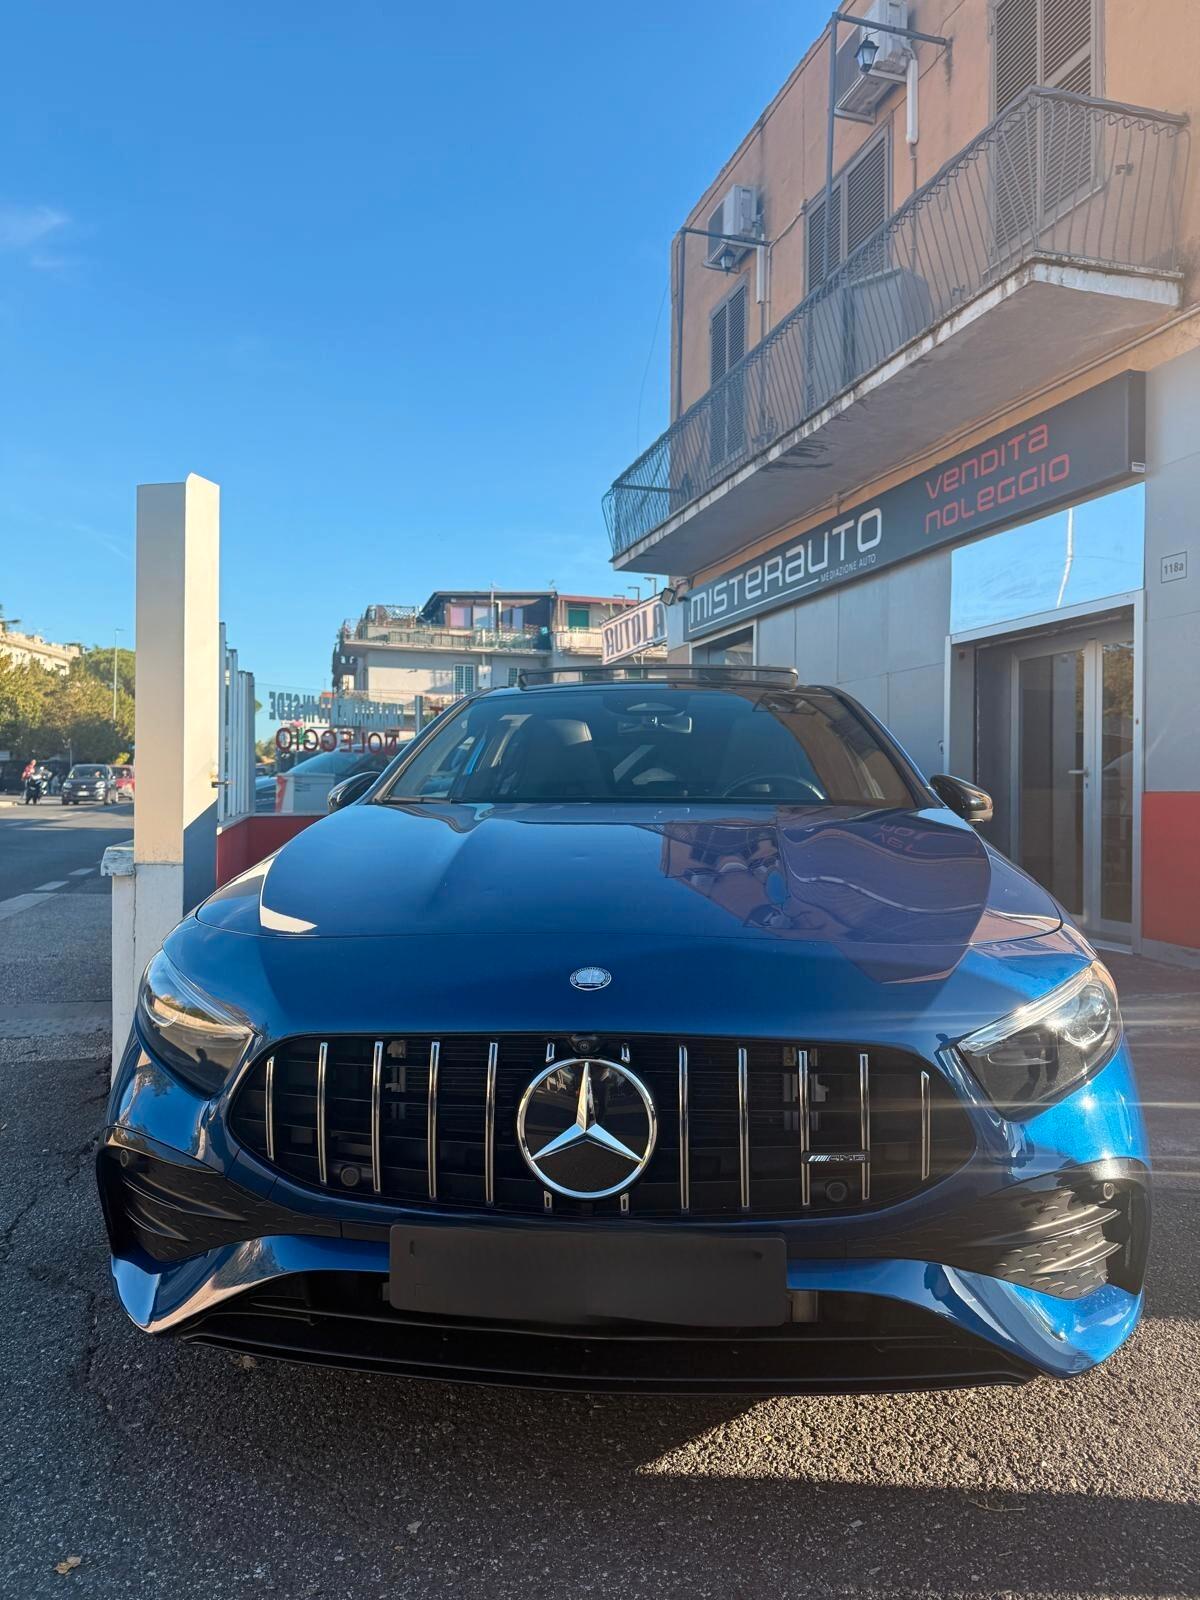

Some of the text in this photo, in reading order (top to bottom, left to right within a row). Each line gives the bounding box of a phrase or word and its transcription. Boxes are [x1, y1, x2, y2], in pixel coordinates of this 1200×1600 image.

[820, 553, 877, 583] MEDIAZIONE AUTO
[1163, 561, 1185, 576] 118a
